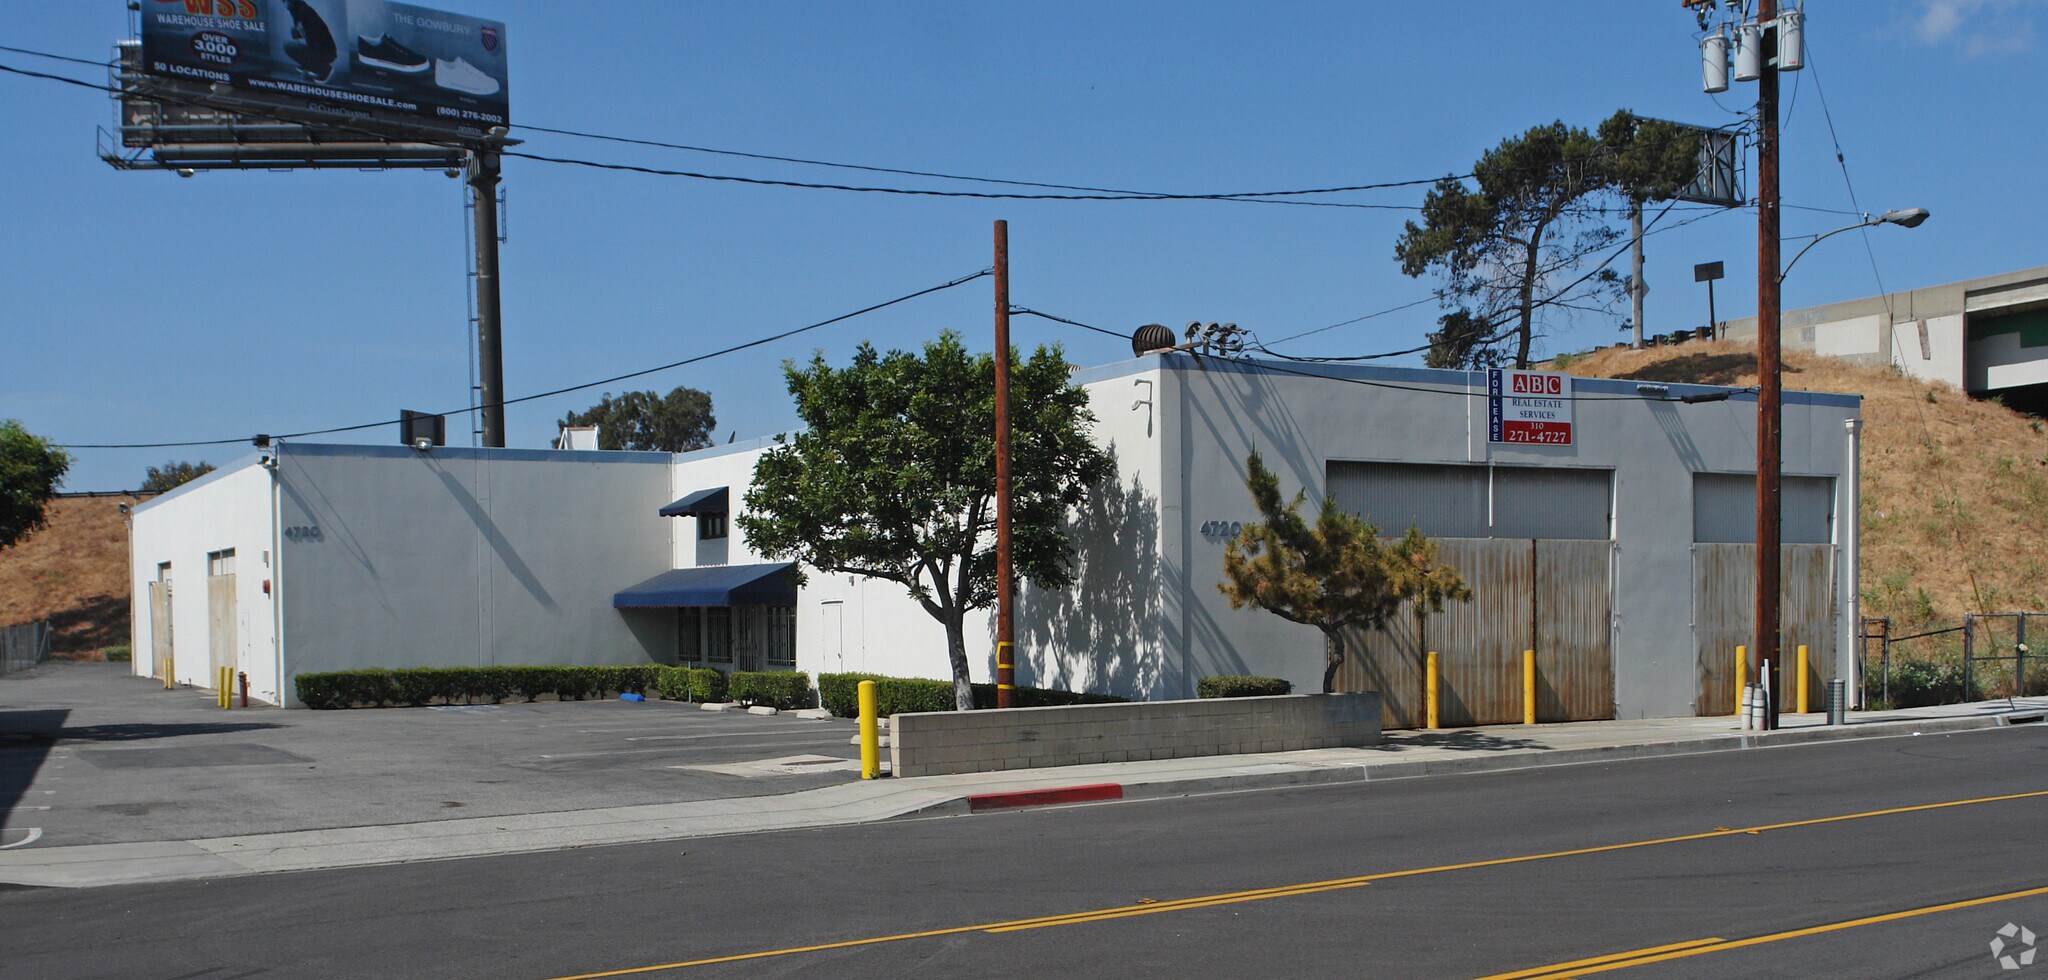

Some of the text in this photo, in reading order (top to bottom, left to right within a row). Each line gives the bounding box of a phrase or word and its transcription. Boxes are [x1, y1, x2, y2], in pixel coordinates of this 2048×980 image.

[156, 13, 265, 32] WAREHOUSE SHOE SALE
[392, 13, 414, 25] THE
[416, 17, 471, 35] GOWBURY
[202, 33, 228, 44] OVER
[200, 52, 232, 65] STYLES
[154, 61, 230, 81] 50 LOCATIONS
[436, 106, 502, 123] (800) 276-2002
[1514, 375, 1561, 394] ABC
[1512, 398, 1563, 409] REAL ESTATE
[1519, 410, 1556, 420] SERVICES
[1530, 422, 1544, 430] 310
[1508, 430, 1567, 444] 271-4727
[284, 526, 321, 538] 4720
[1199, 520, 1242, 537] 4720
